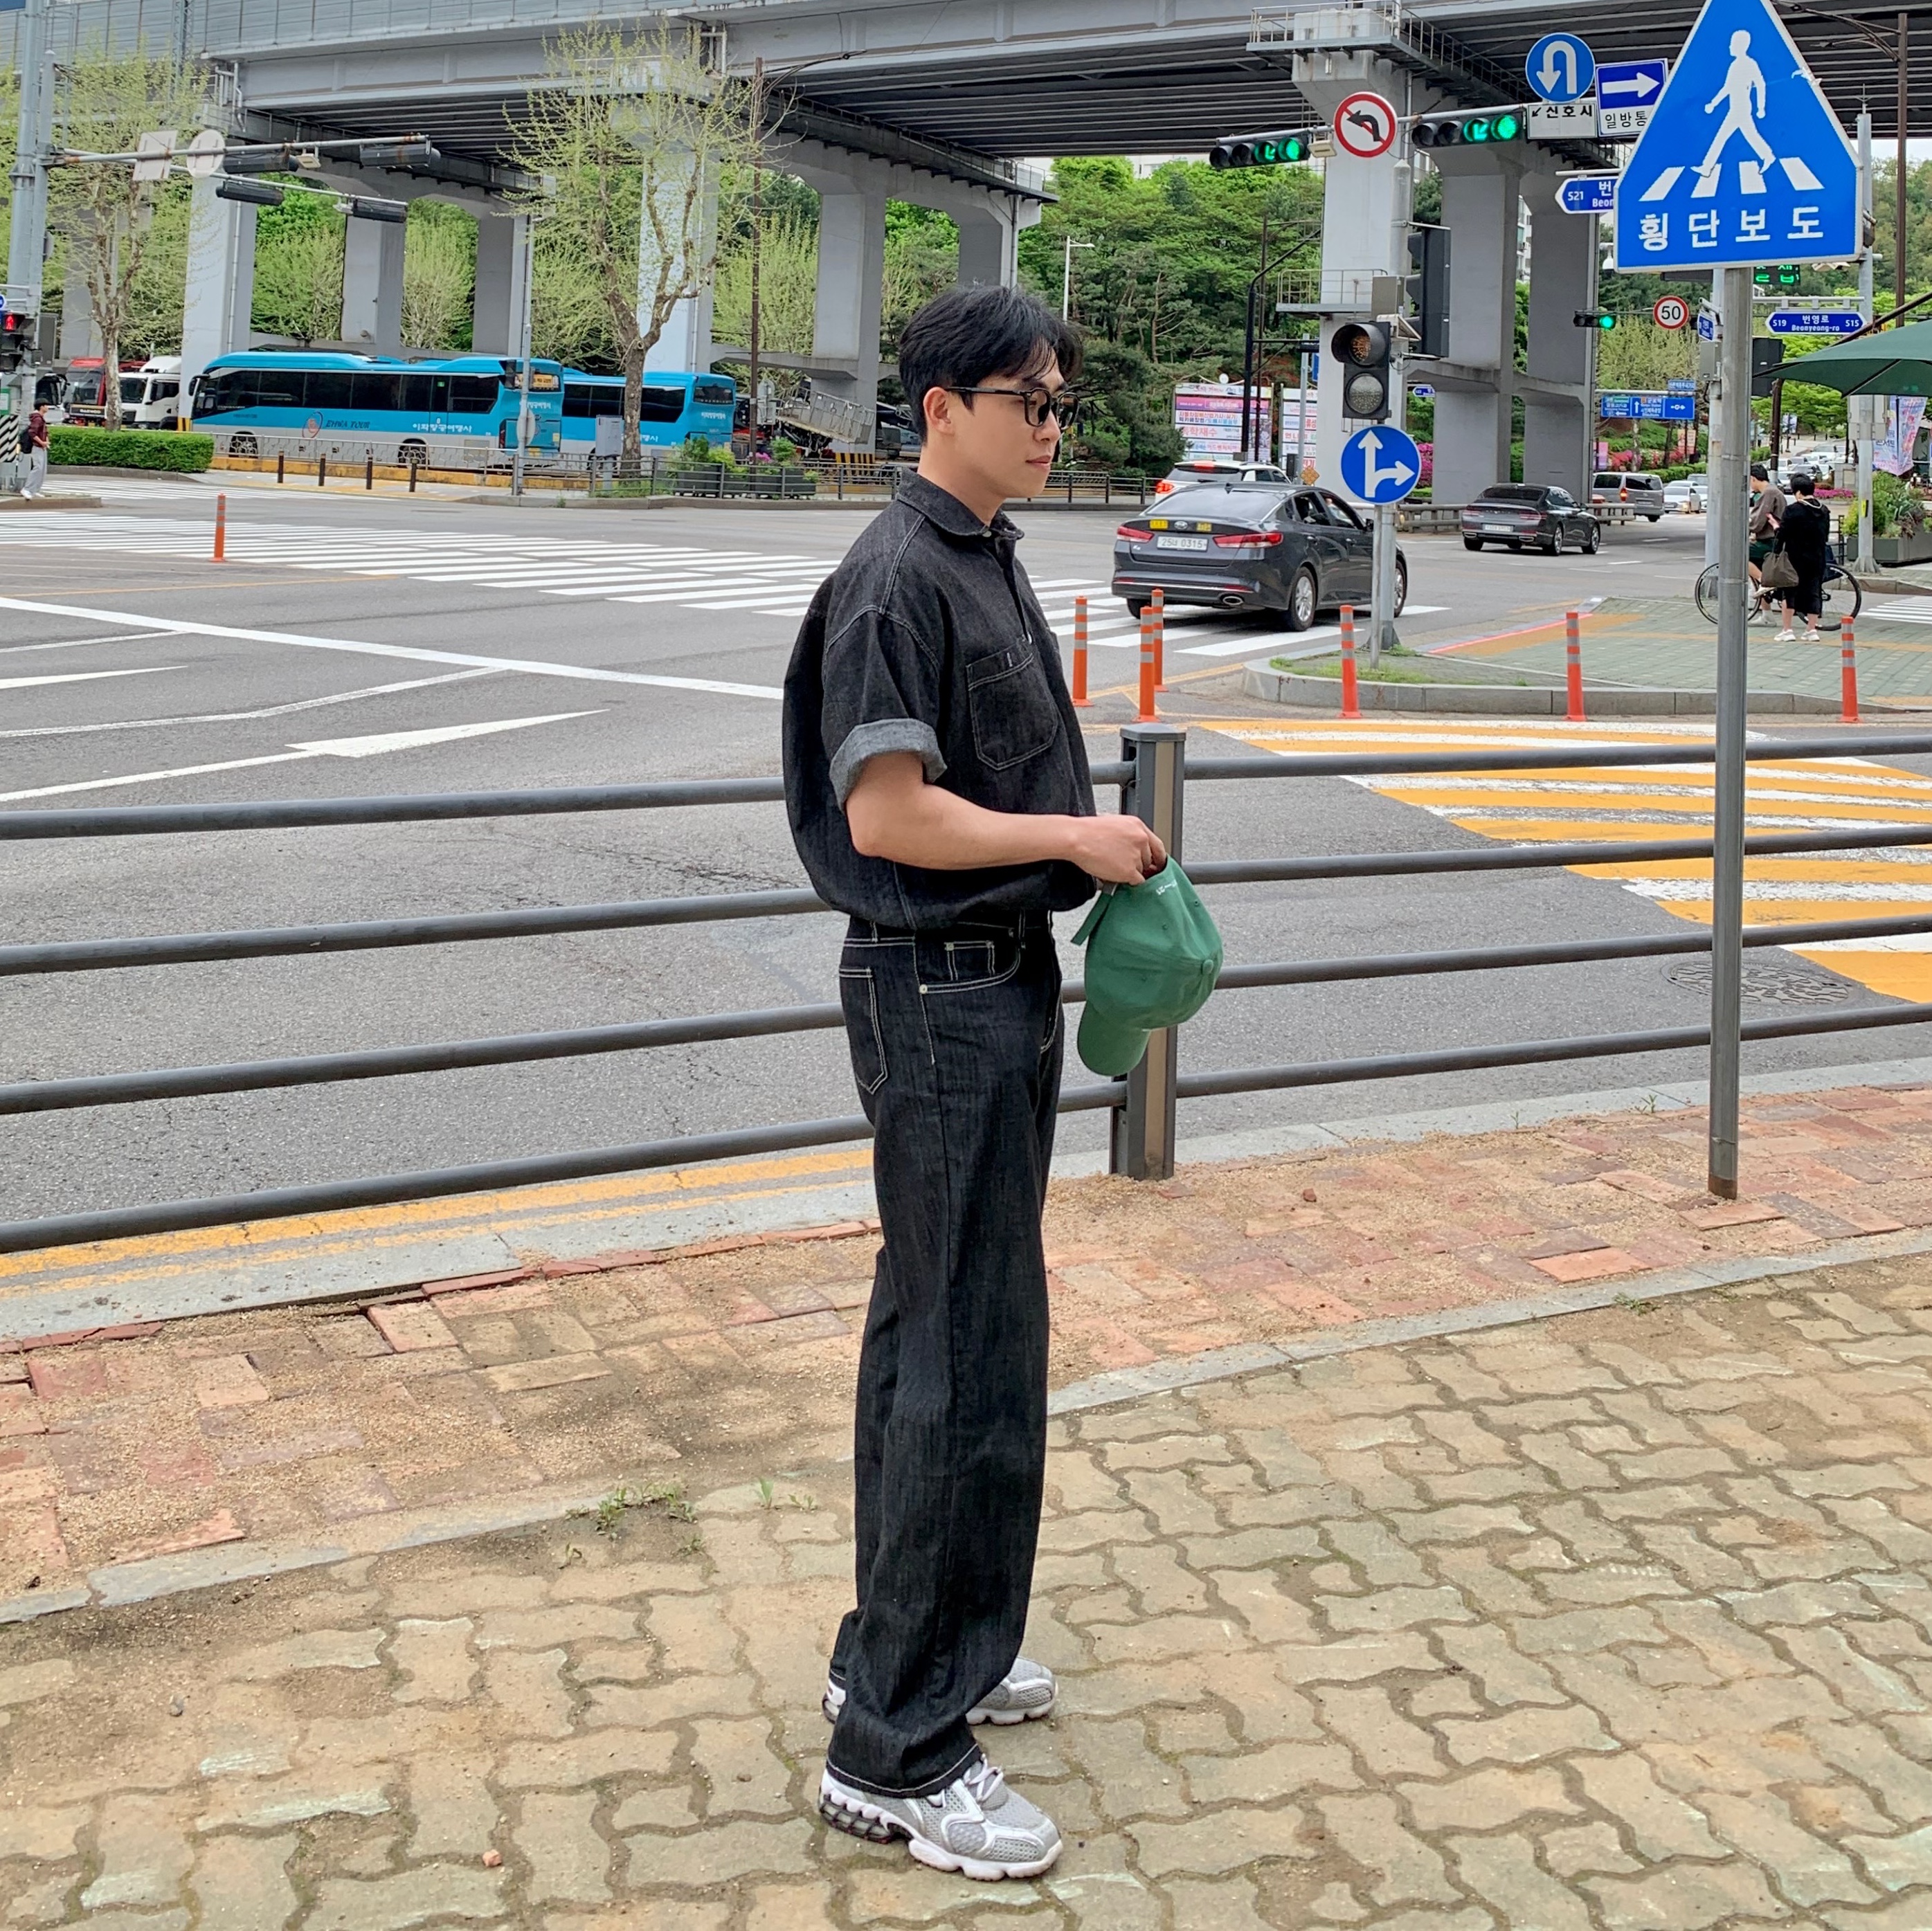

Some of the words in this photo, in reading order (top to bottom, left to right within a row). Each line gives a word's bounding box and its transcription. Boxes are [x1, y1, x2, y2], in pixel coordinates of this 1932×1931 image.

[1546, 105, 1592, 118] 신호시
[1605, 111, 1647, 129] 일방통
[1598, 181, 1611, 197] 번
[1567, 191, 1584, 201] 521
[1592, 198, 1614, 207] Beon
[1638, 206, 1824, 251] 횡단보도
[1661, 306, 1681, 320] 50
[1802, 315, 1830, 325] 번영로
[1845, 319, 1859, 327] 515
[350, 420, 370, 428] TOUR
[1181, 538, 1203, 548] 0315
